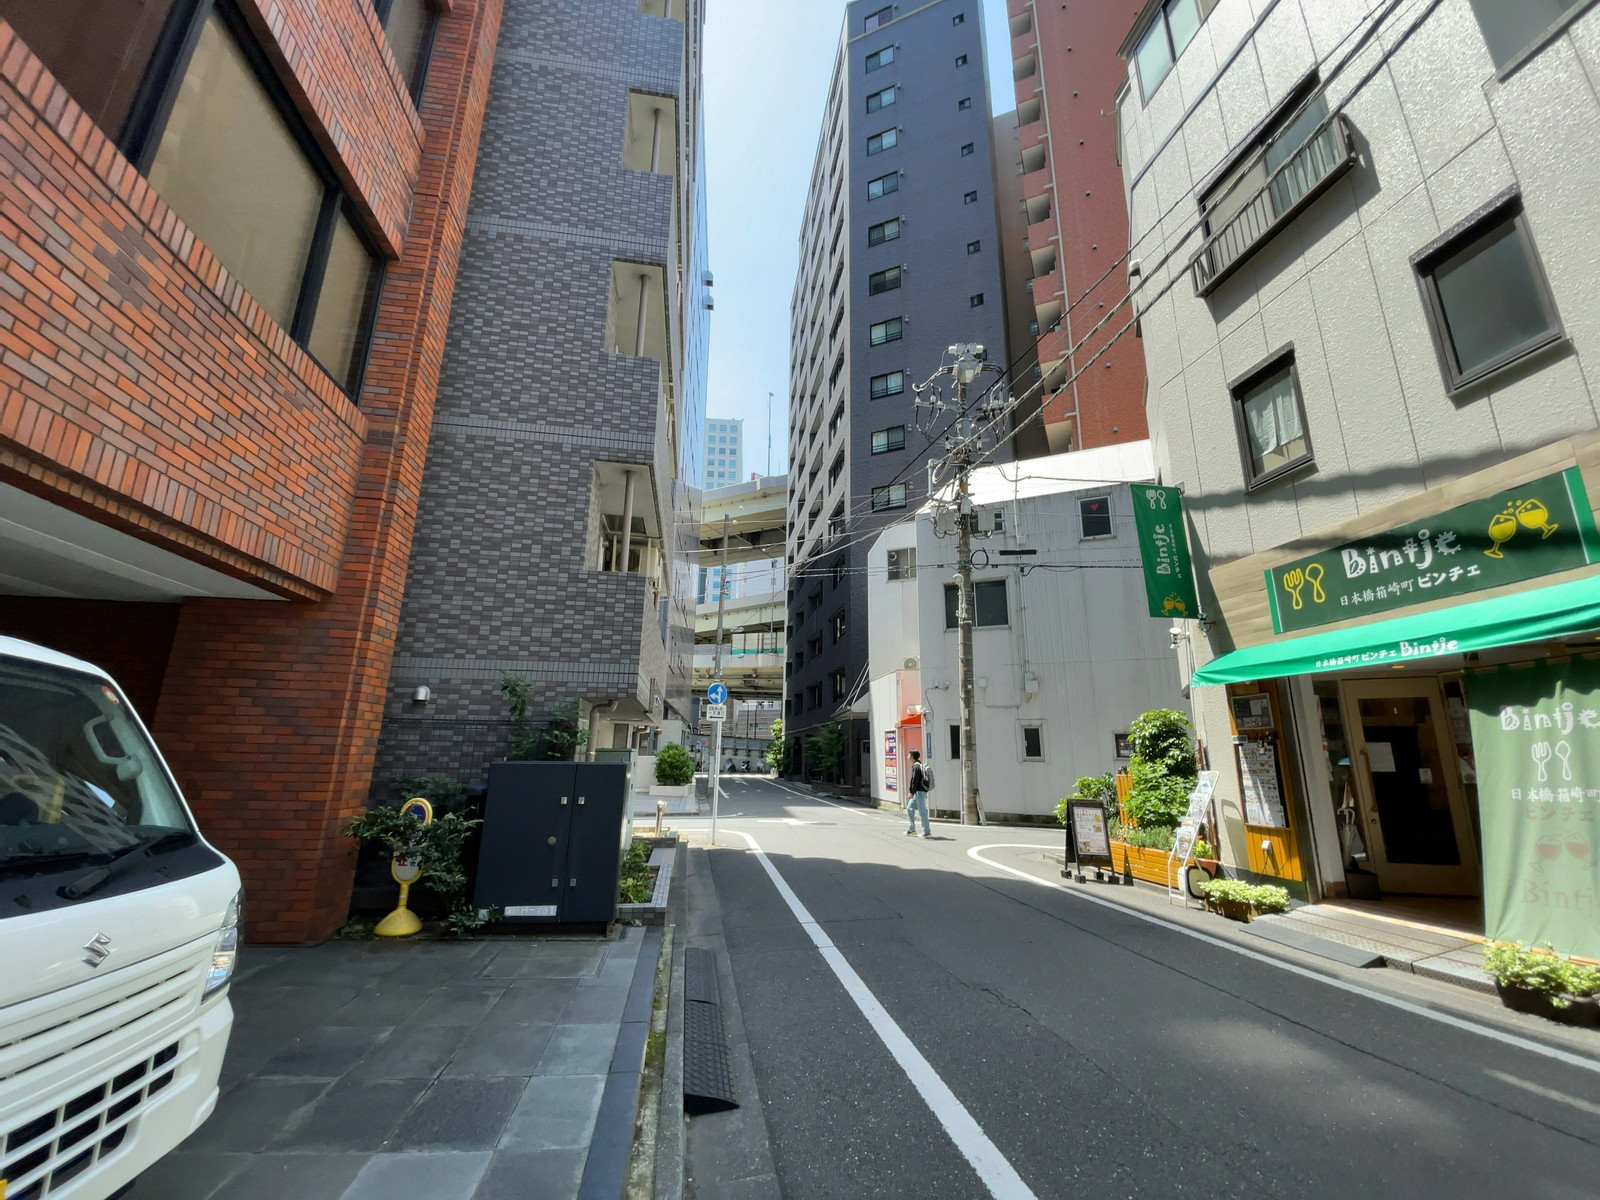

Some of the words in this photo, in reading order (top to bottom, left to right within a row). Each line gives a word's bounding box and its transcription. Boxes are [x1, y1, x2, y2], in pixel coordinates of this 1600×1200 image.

[1153, 524, 1171, 574] Bintje
[1341, 529, 1461, 579] Bintje
[1340, 579, 1414, 606] 日本橋箱崎町
[1417, 564, 1480, 588] ビンチェ
[1361, 649, 1397, 661] ビンチェ
[1400, 637, 1459, 657] Bintje
[1500, 702, 1600, 735] Bintje
[1520, 878, 1600, 918] Bintj
